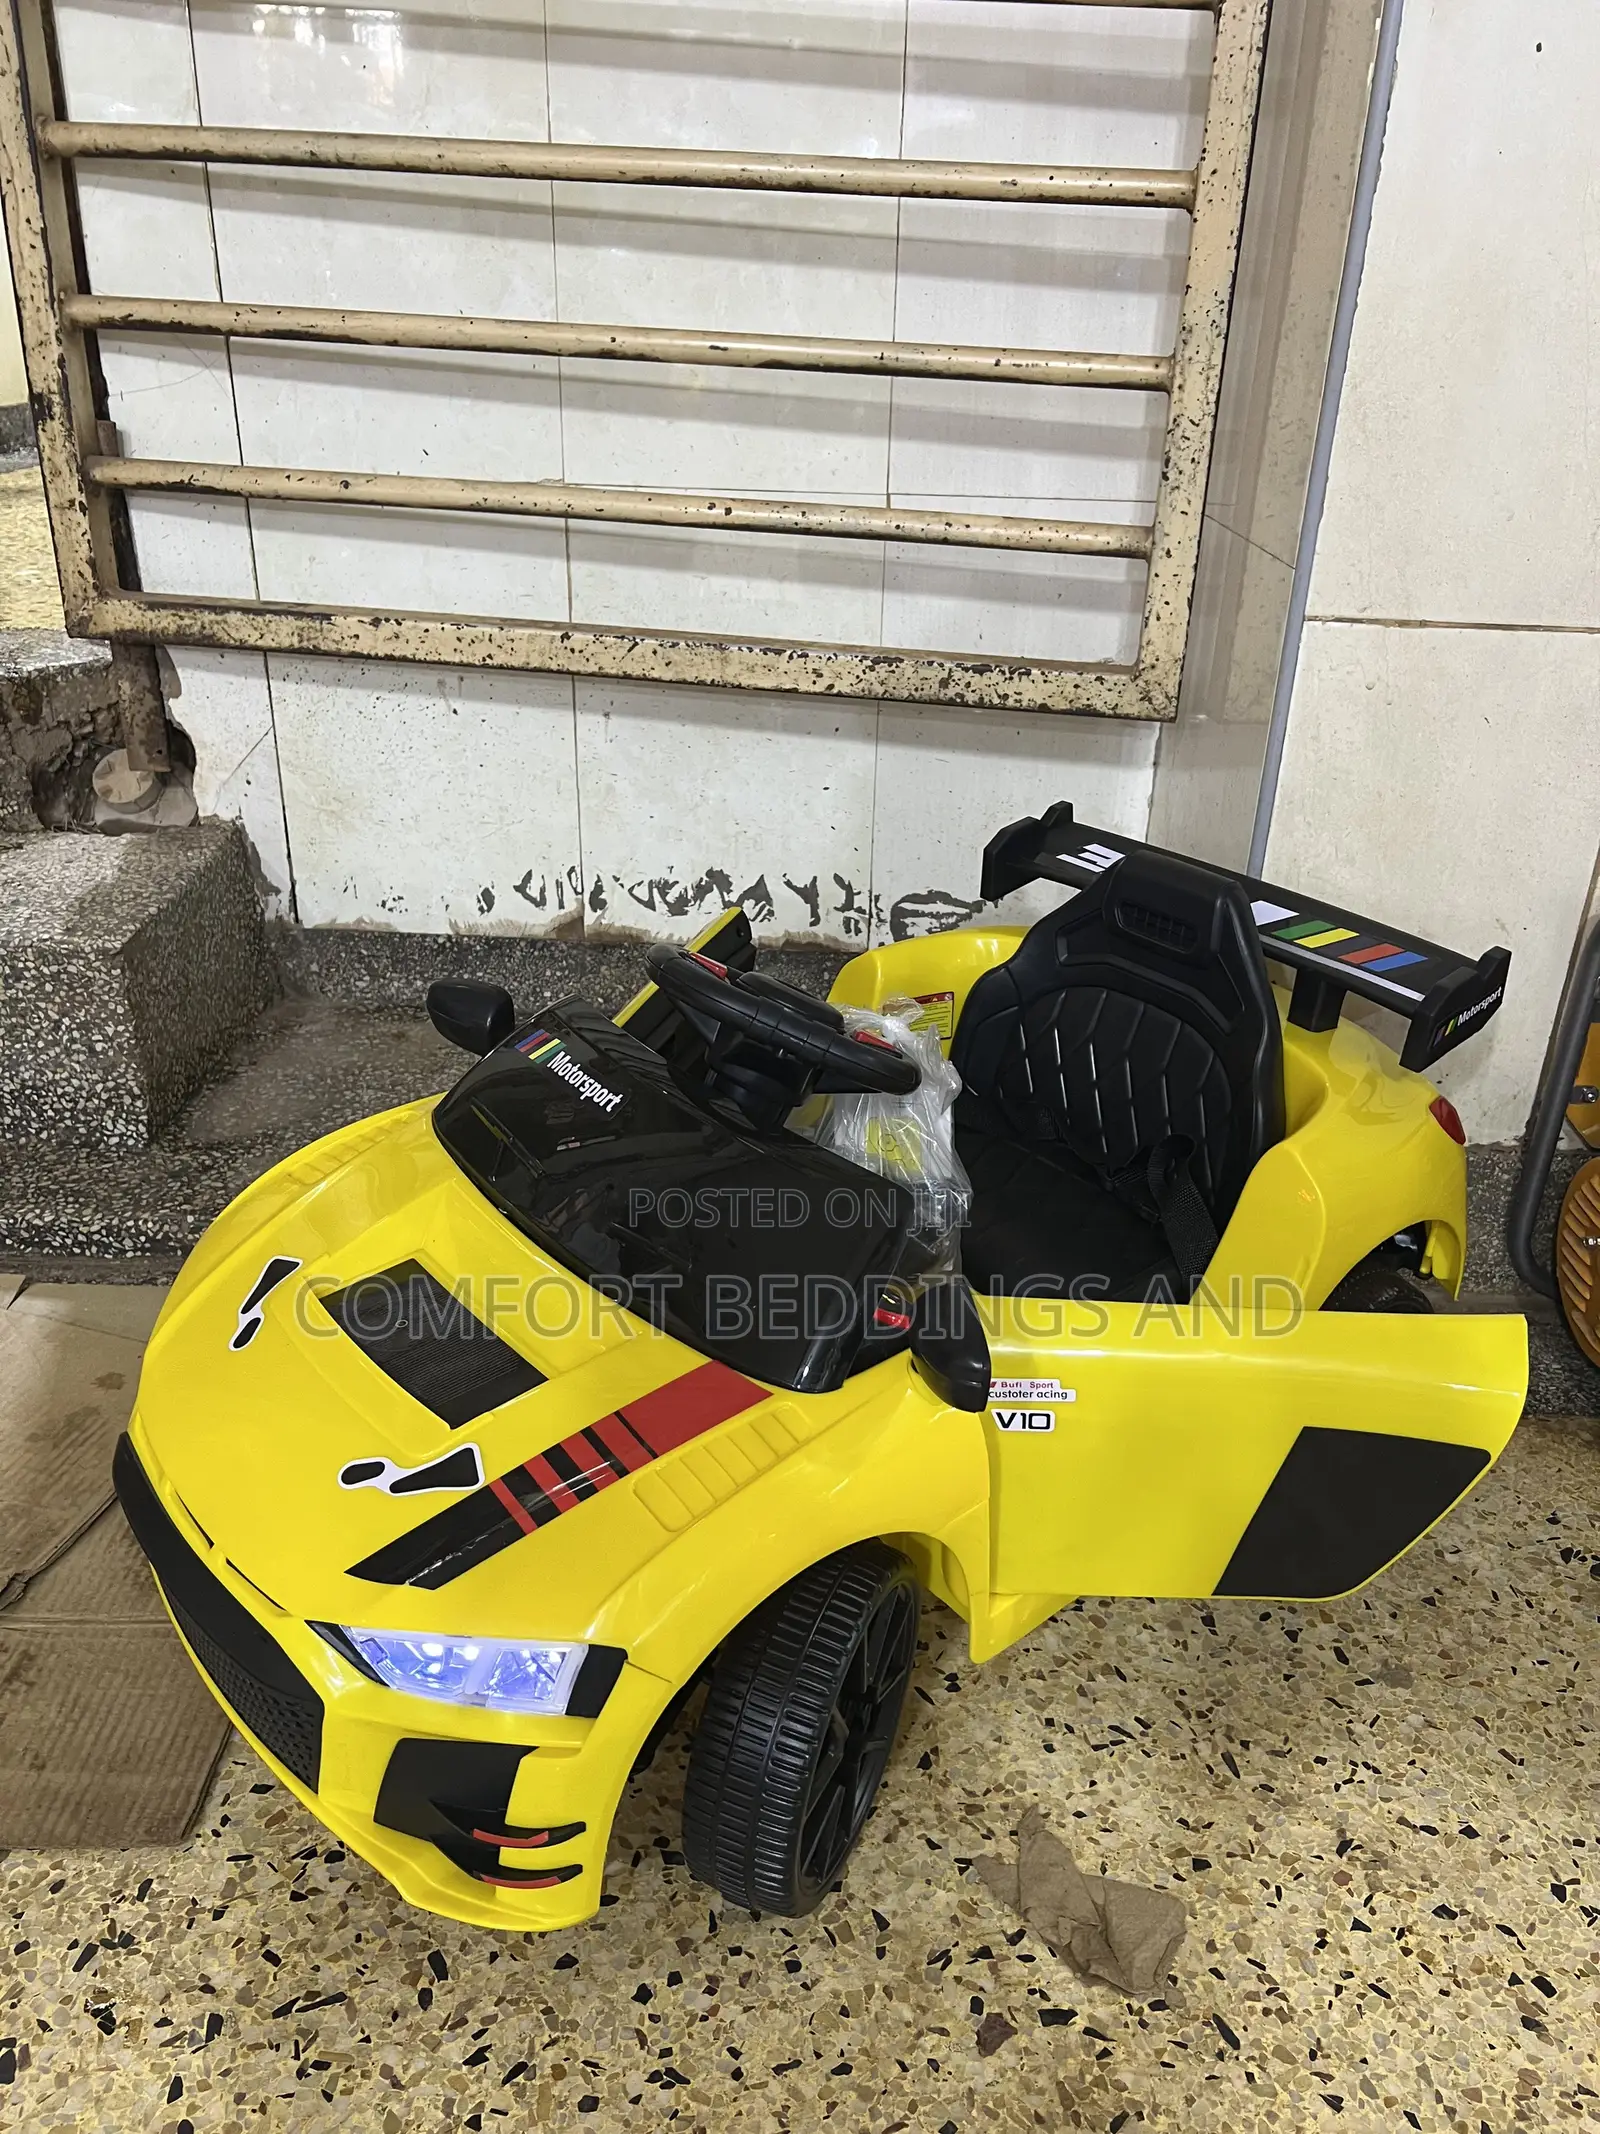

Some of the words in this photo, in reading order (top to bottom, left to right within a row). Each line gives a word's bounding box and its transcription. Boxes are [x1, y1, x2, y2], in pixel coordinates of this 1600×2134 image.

[1457, 986, 1502, 1027] Motorsport
[546, 1050, 624, 1113] Motorsport
[1029, 1381, 1054, 1389] Sport
[996, 1412, 1051, 1430] V10
